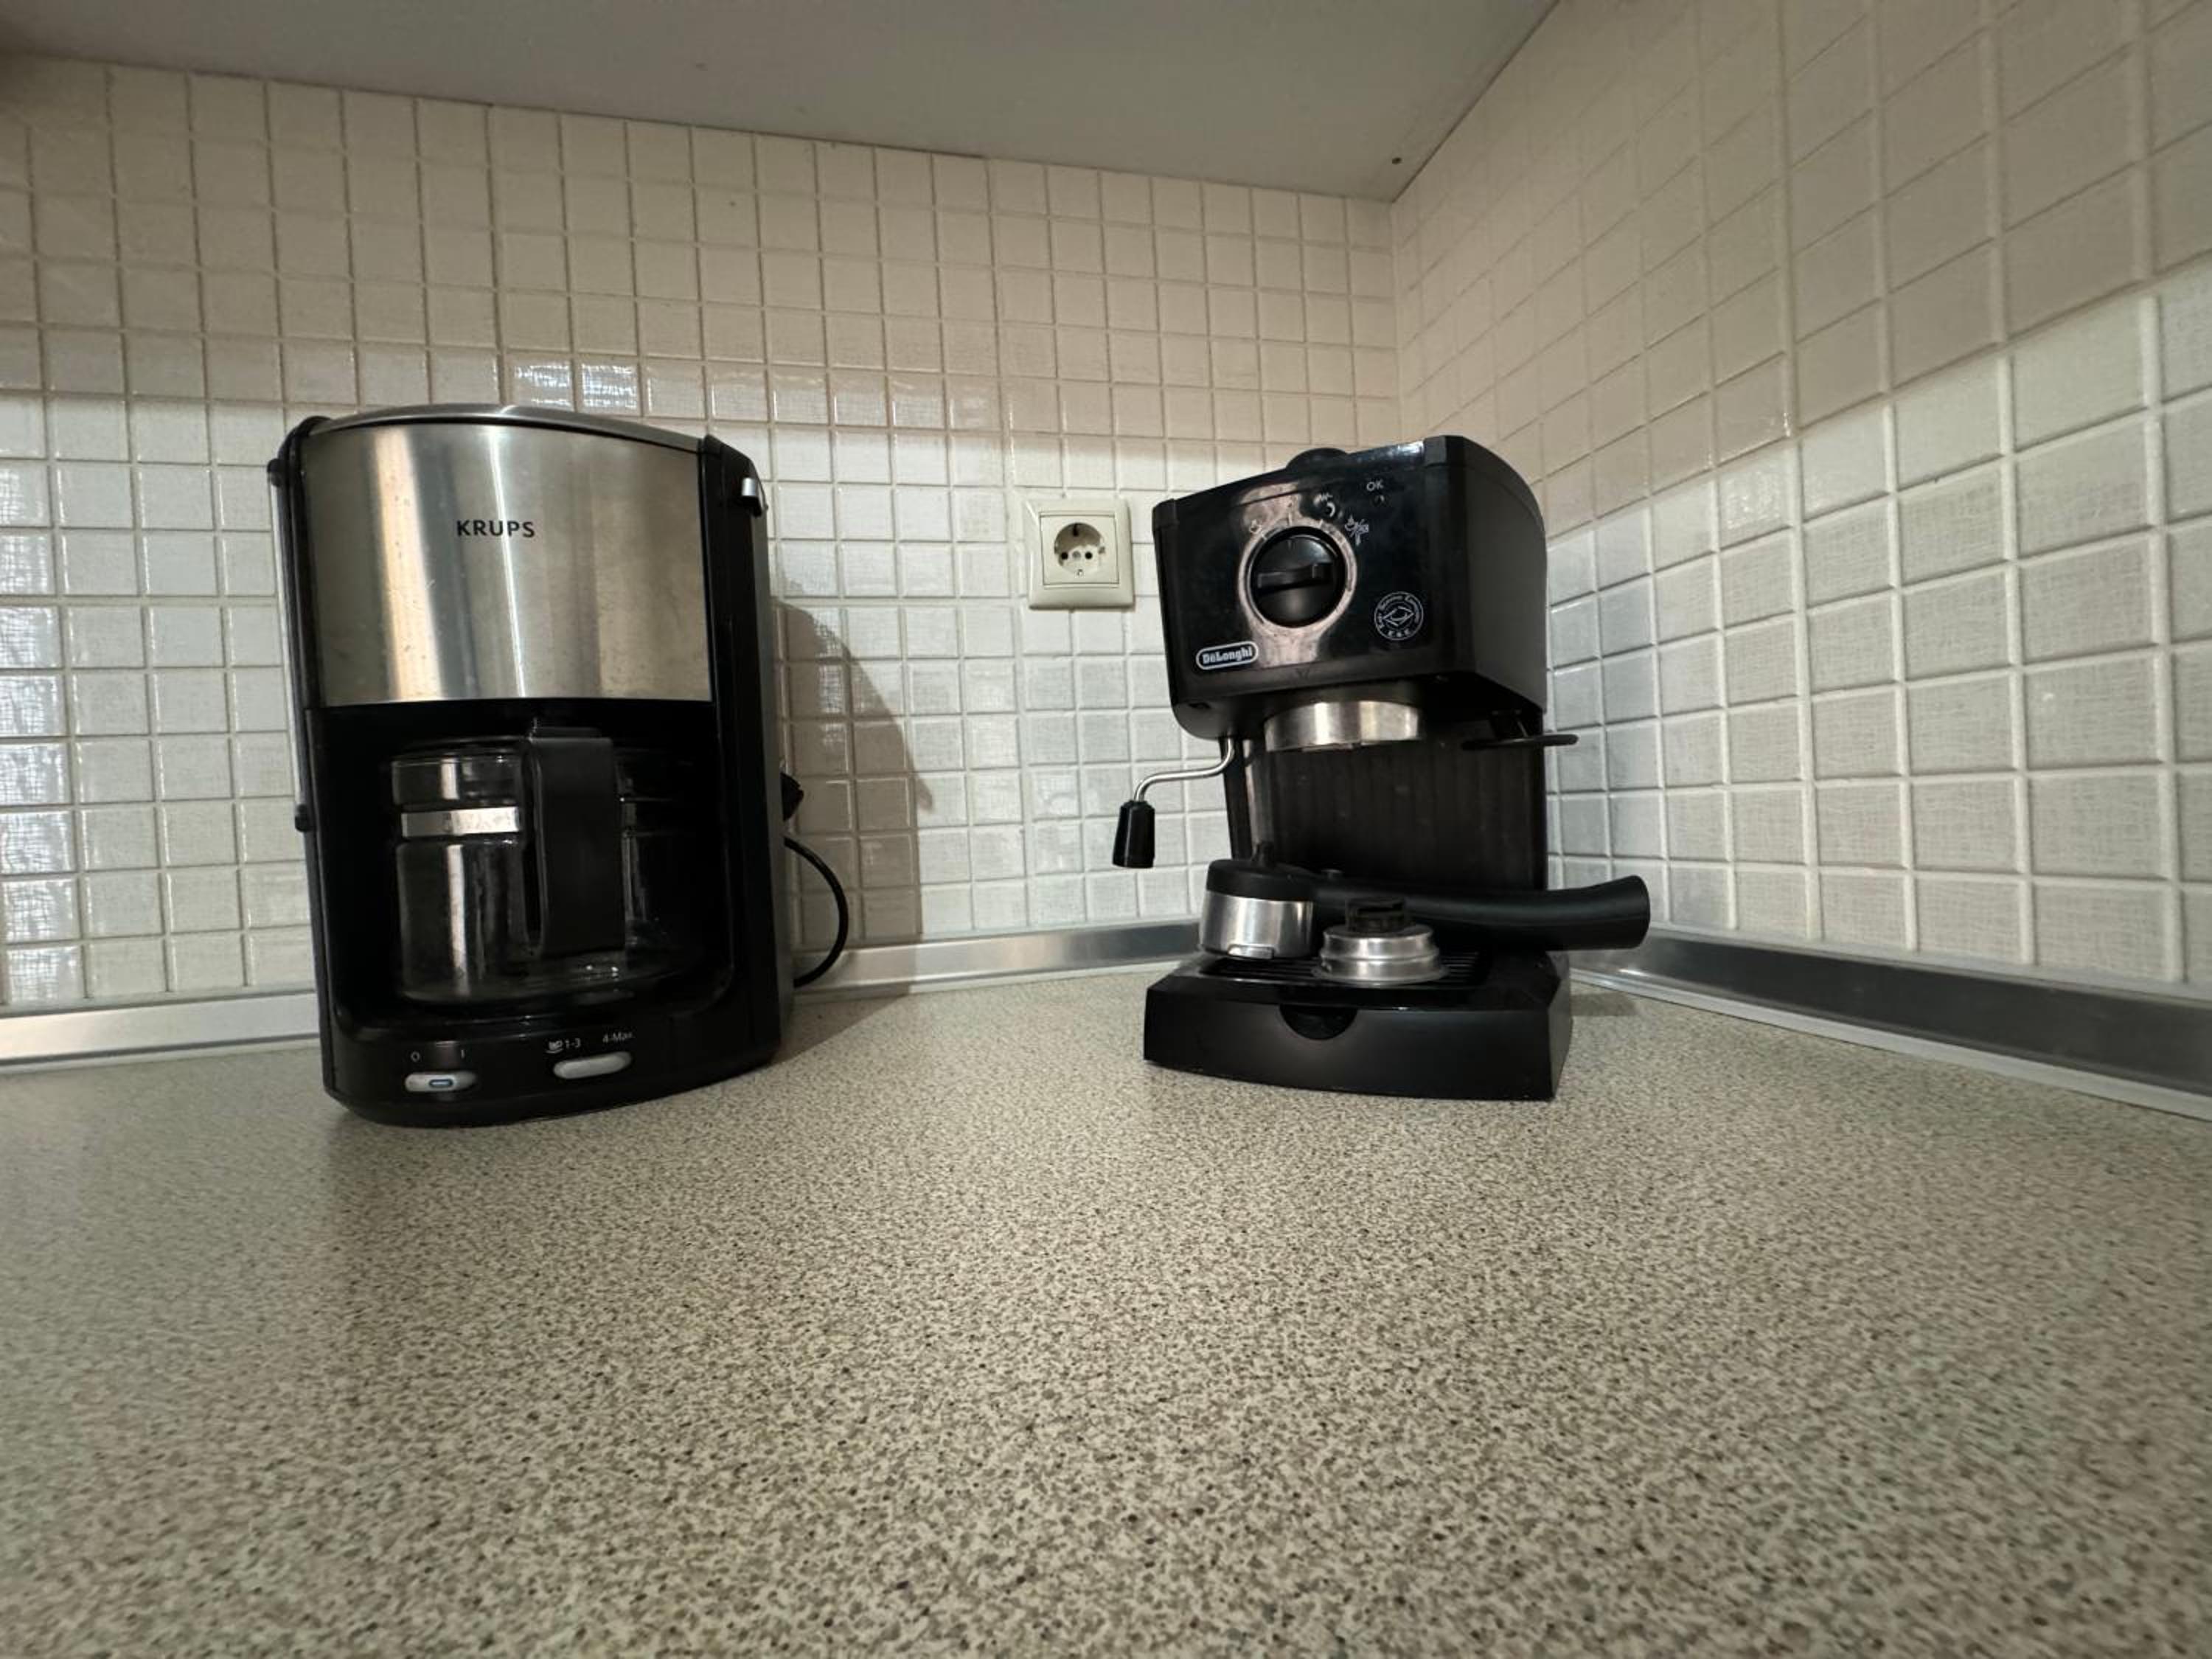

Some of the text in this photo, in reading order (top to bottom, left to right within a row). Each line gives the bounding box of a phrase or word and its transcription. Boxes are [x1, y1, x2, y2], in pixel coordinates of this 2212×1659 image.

[1366, 479, 1384, 492] OK
[456, 519, 535, 538] KRUPS
[1202, 647, 1253, 664] DeLonghi
